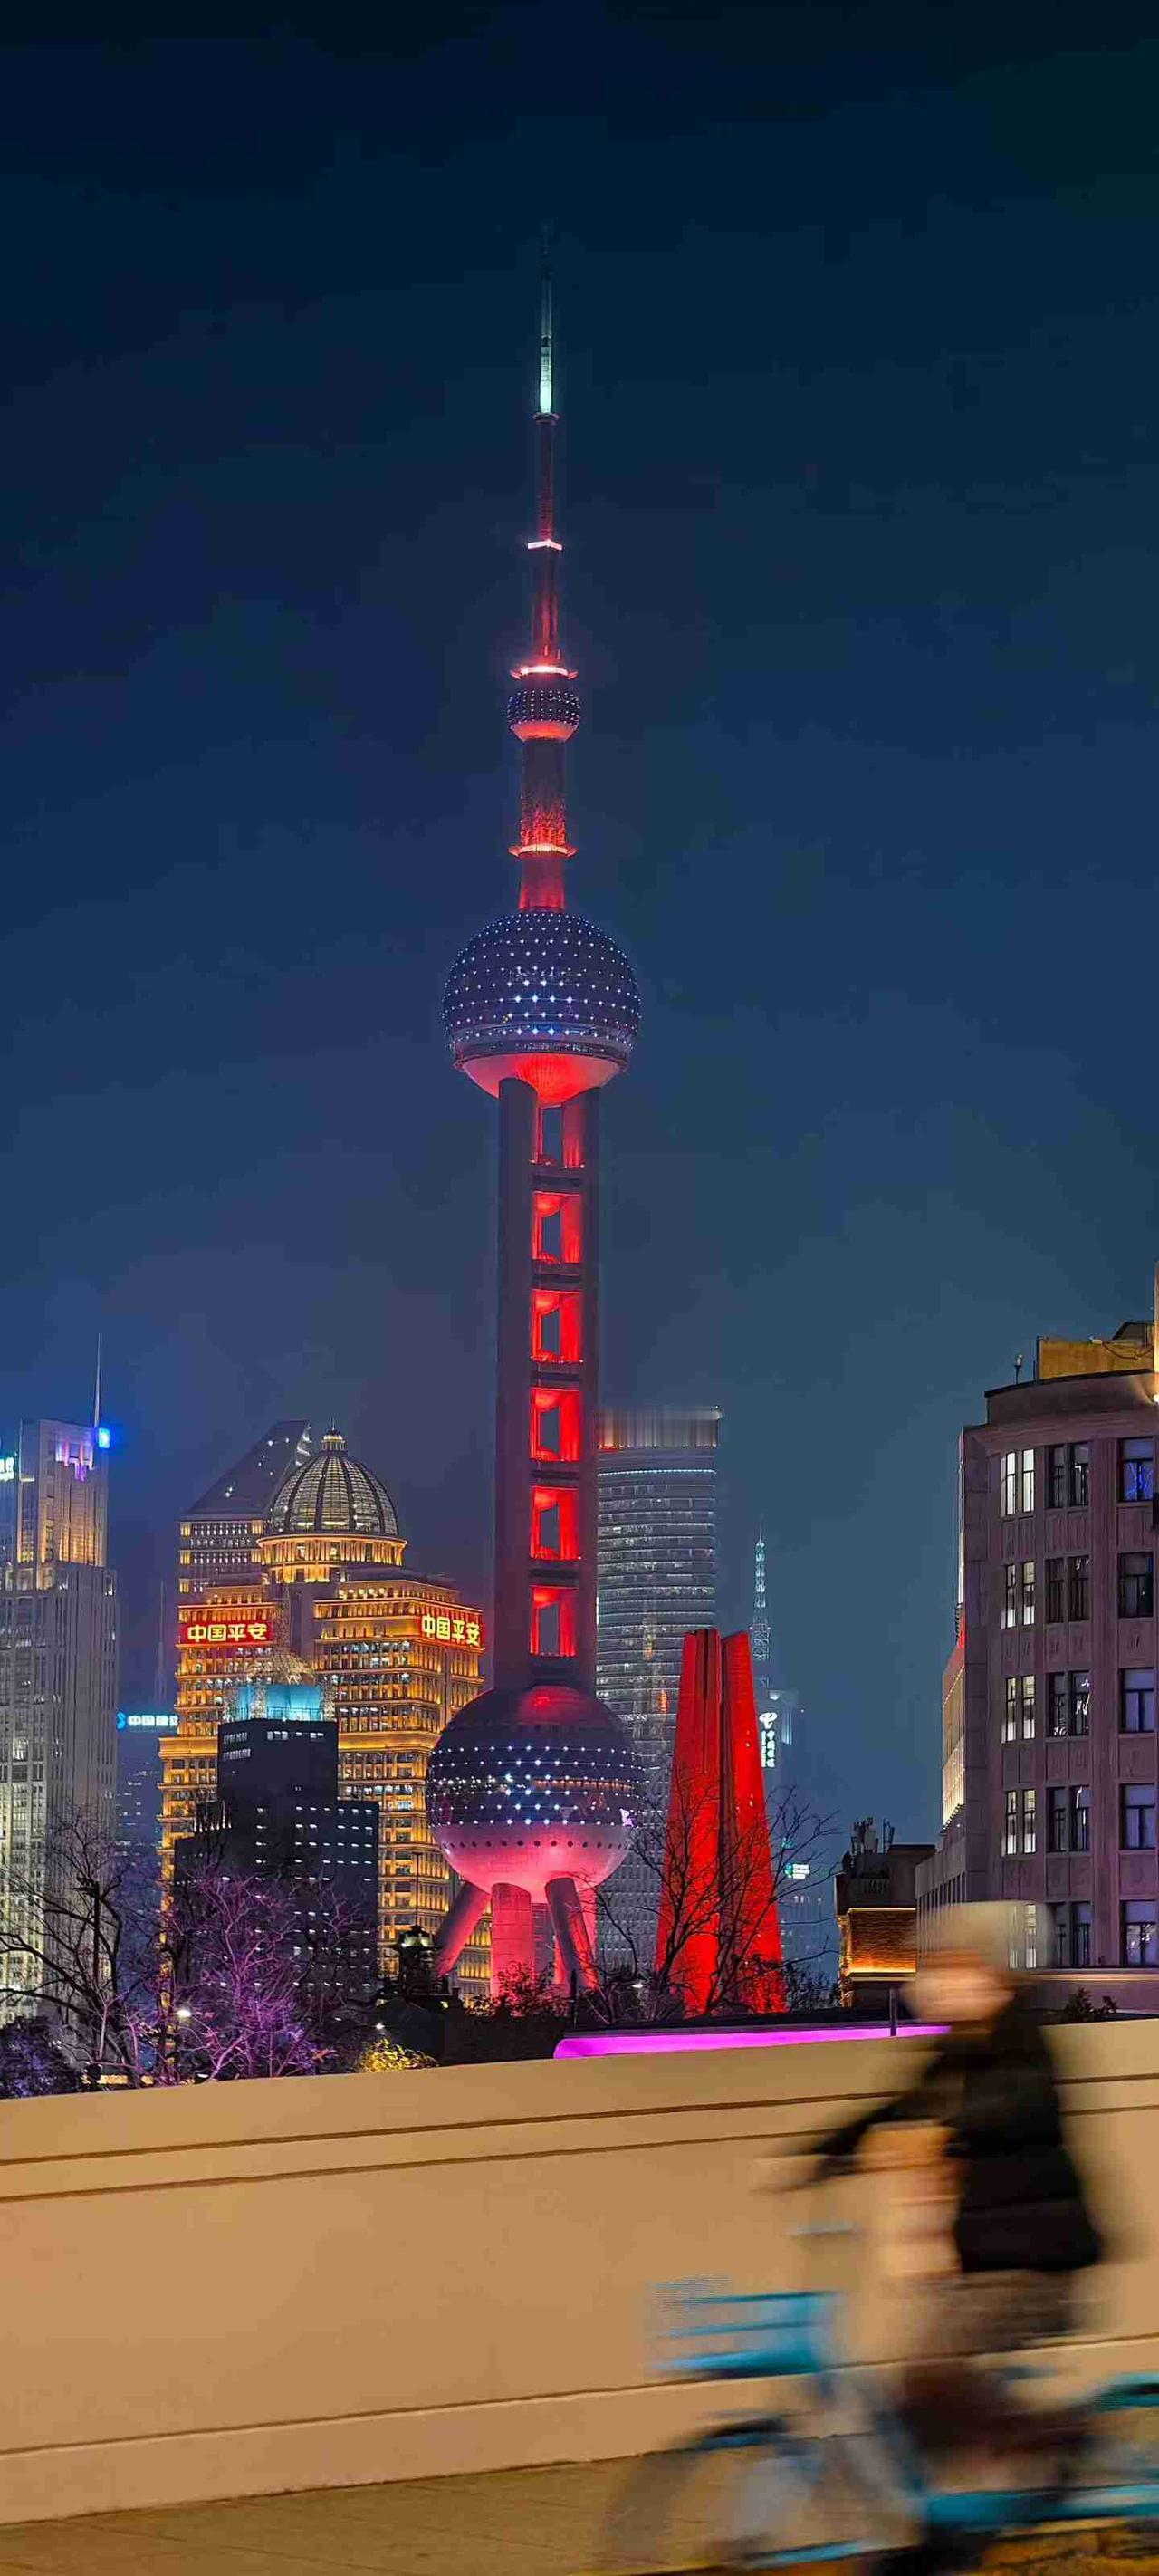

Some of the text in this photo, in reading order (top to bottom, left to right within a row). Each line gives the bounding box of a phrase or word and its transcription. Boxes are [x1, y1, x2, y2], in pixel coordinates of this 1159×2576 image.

[187, 1623, 267, 1642] 中国平安
[422, 1613, 480, 1647] 中国平安
